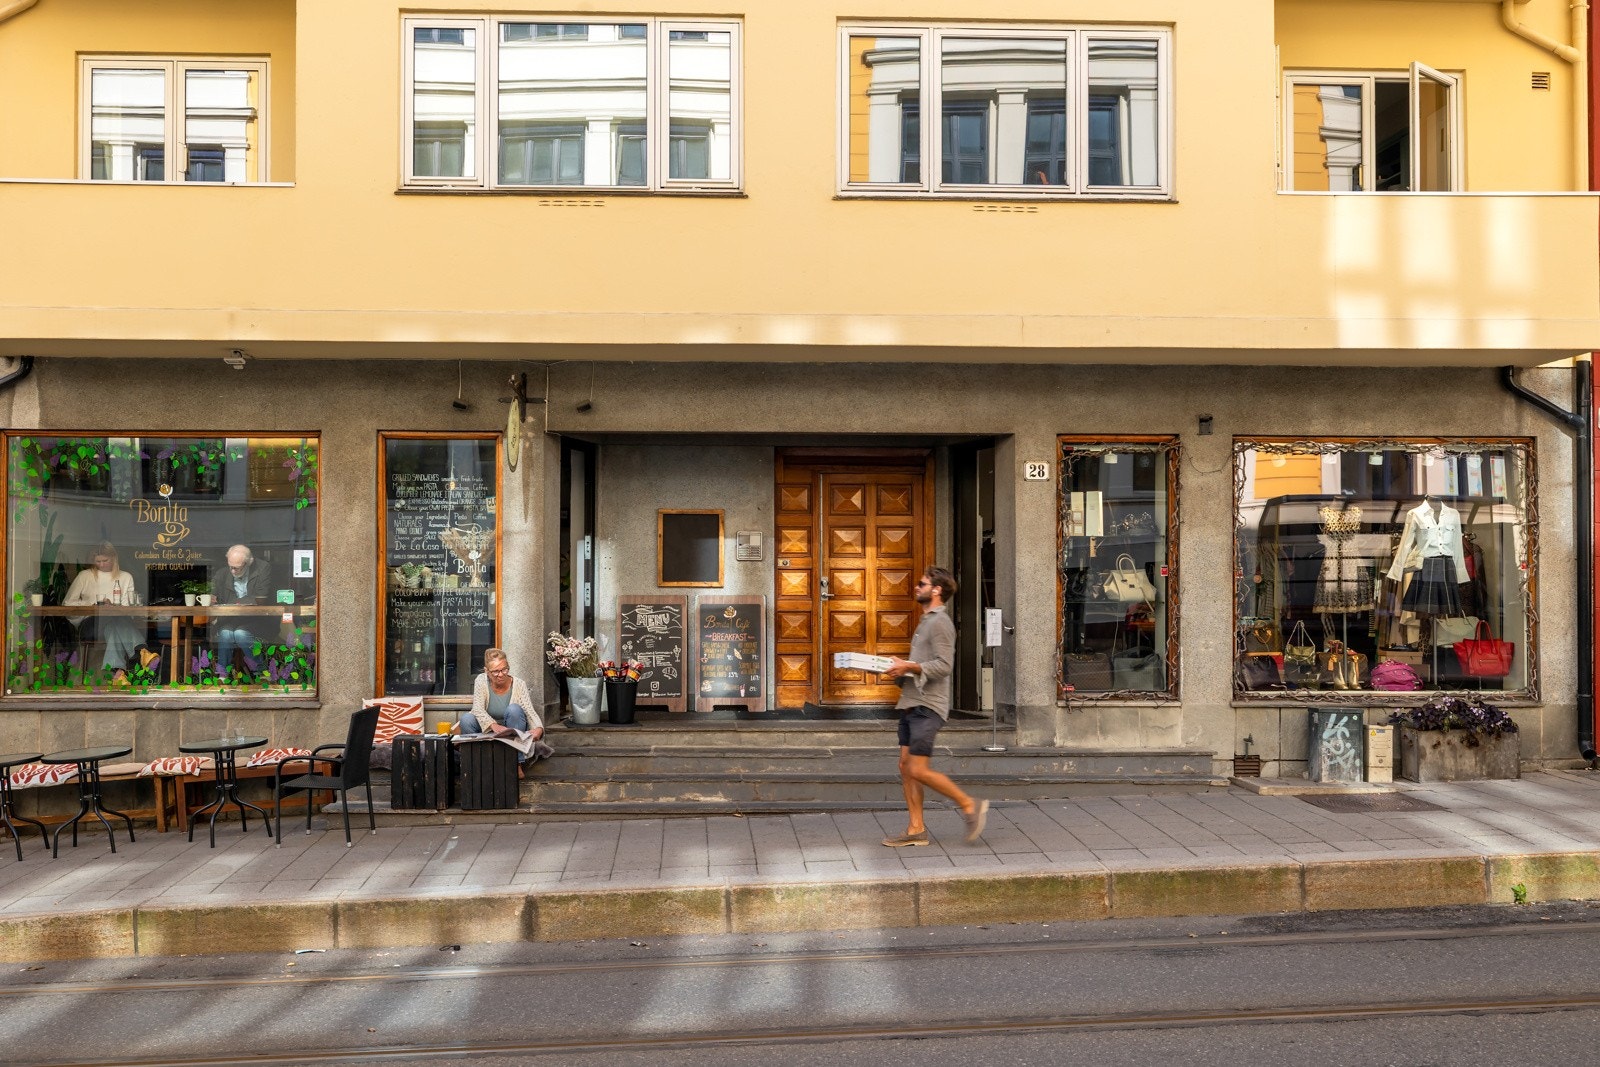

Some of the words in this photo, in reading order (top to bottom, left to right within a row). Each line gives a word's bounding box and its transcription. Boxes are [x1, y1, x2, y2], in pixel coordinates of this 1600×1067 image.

[1029, 464, 1045, 478] 28
[412, 473, 440, 482] SANDWICHES
[423, 482, 438, 491] PASTA
[129, 498, 188, 523] Bonita
[394, 519, 422, 528] NATURALS
[394, 540, 406, 551] De
[421, 540, 439, 550] Casa
[177, 548, 184, 559] &
[185, 549, 202, 561] Juice
[169, 562, 194, 571] QUALITY
[452, 558, 487, 575] Bonita
[442, 597, 463, 607] PASTA
[636, 613, 670, 627] MENU
[712, 632, 747, 641] BREAKFAST
